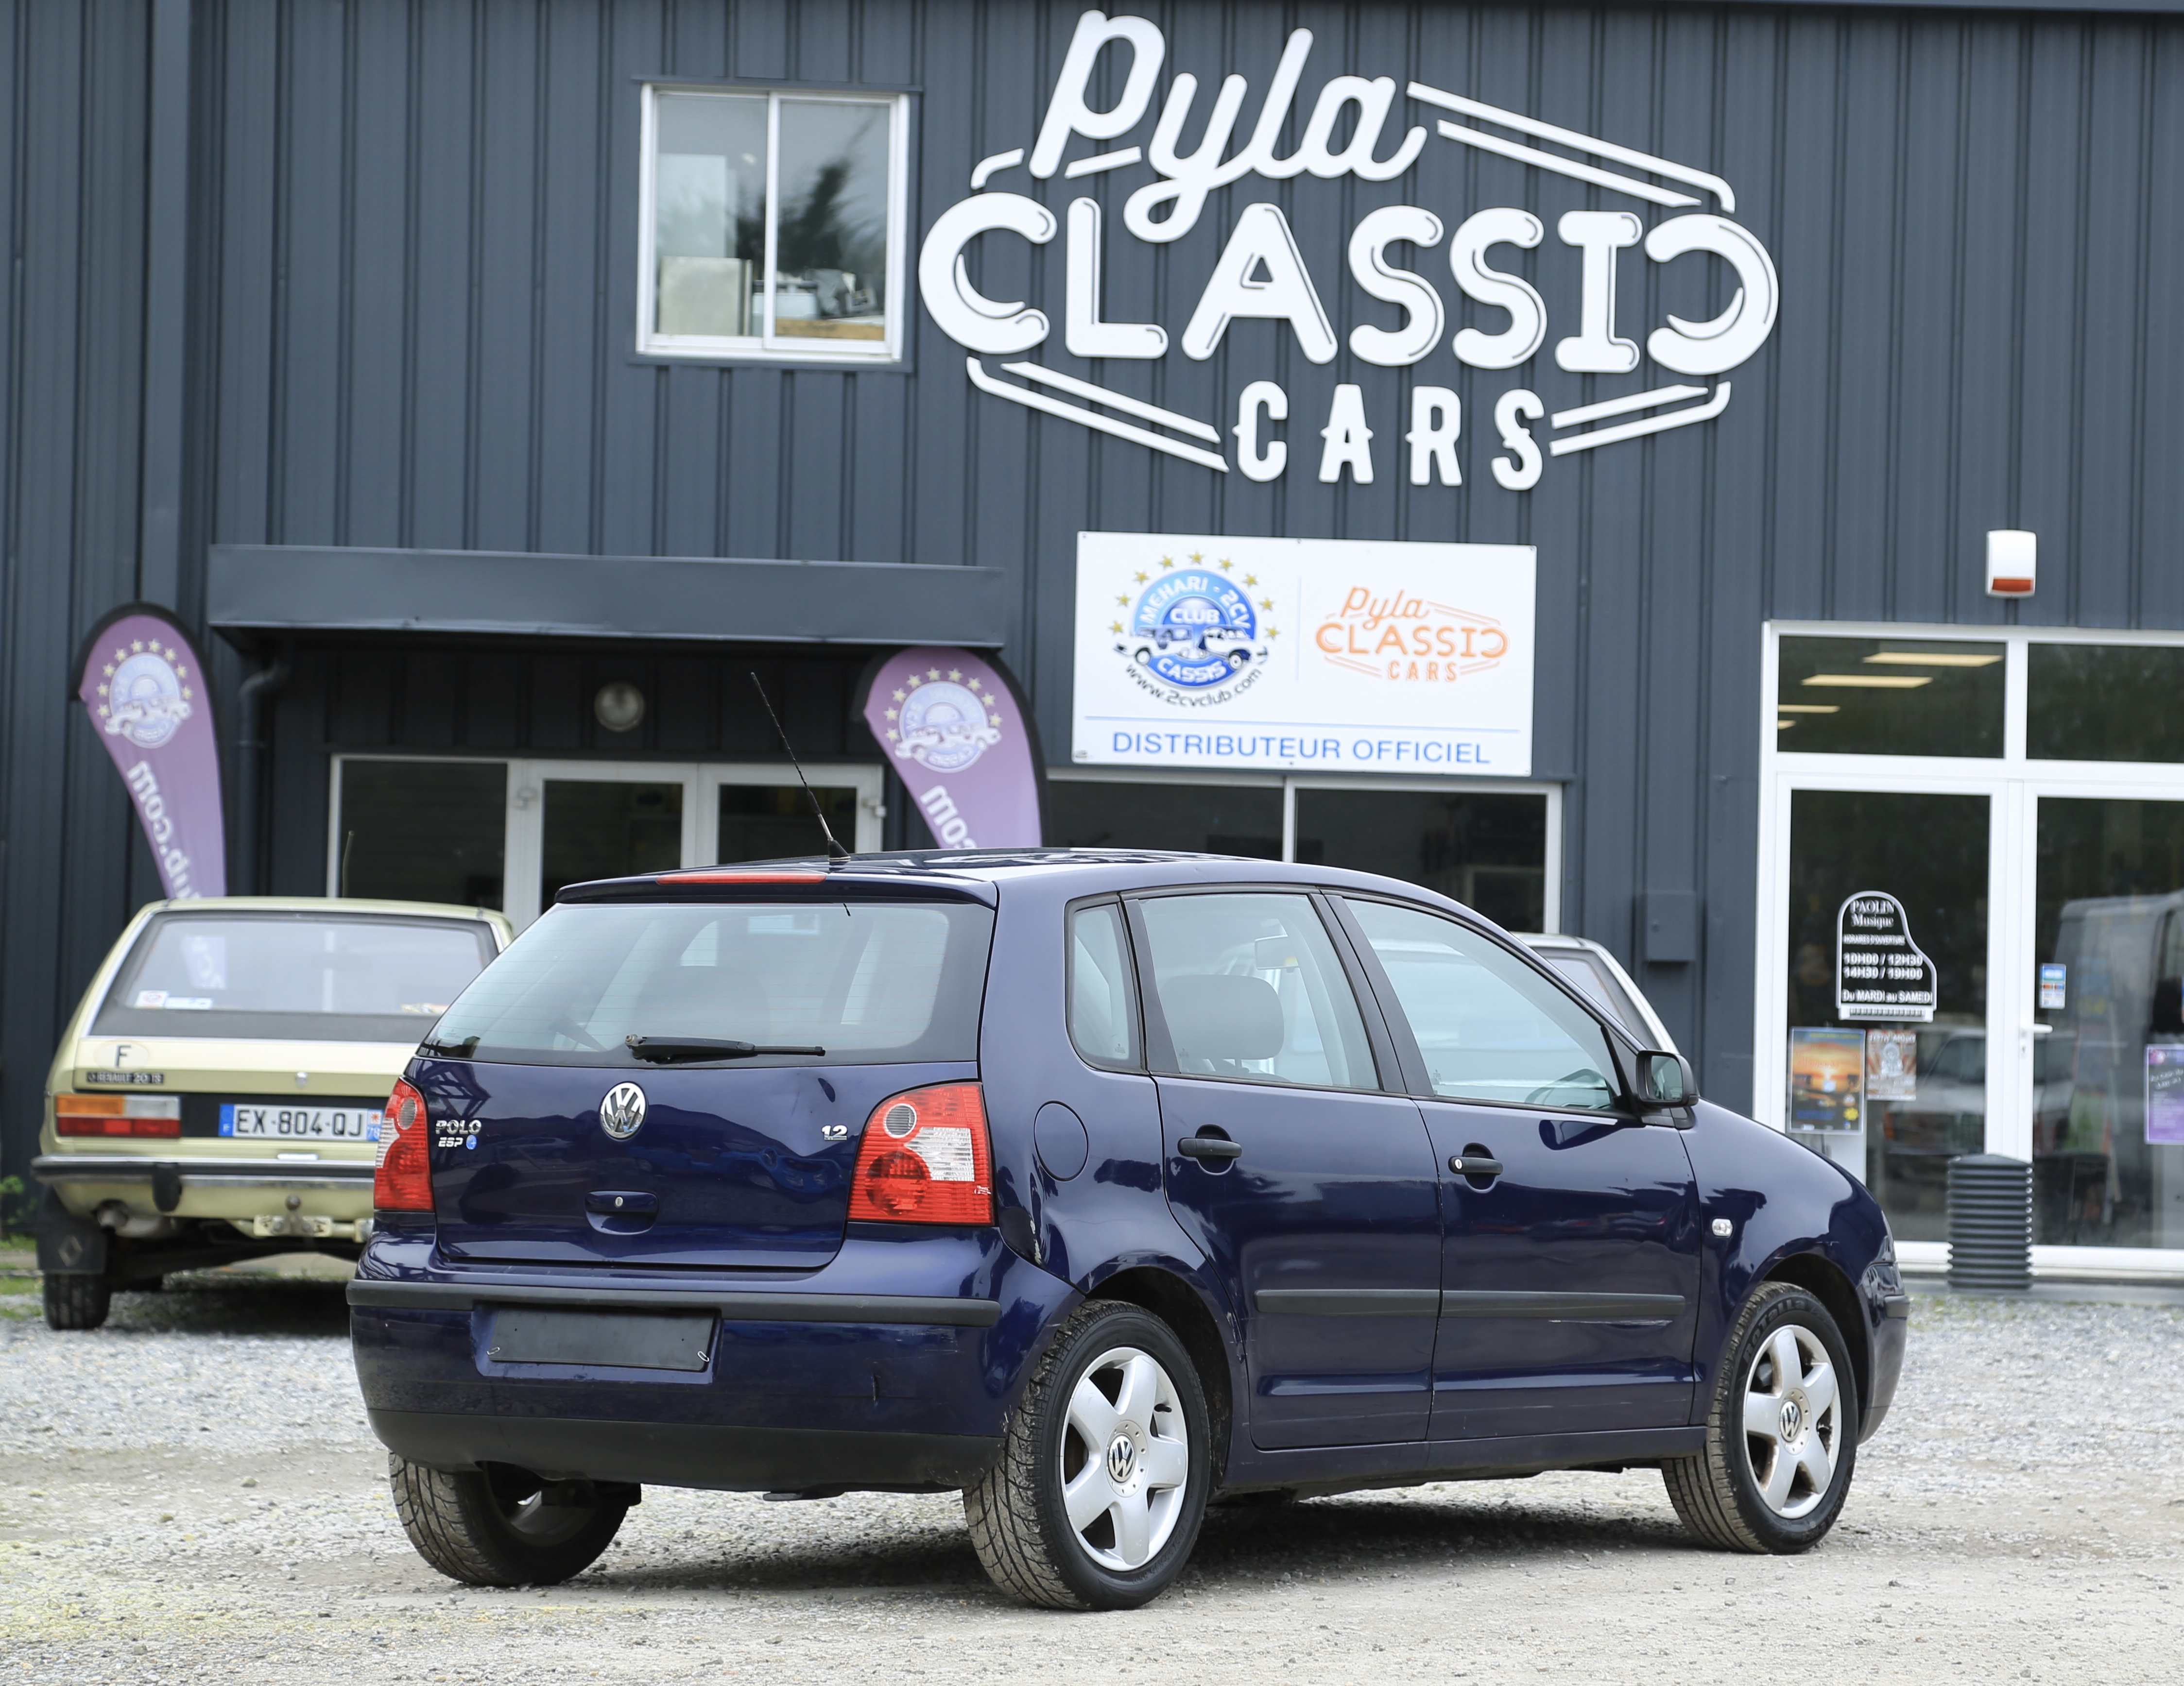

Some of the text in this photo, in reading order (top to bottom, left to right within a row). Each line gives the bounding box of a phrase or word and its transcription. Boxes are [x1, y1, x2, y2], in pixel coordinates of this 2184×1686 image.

[1231, 380, 1545, 491] CARS
[1139, 575, 1209, 626] MEHARI
[1220, 589, 1252, 630] 2CV
[1340, 585, 1431, 630] Pyla
[1169, 607, 1221, 625] CLUB
[1156, 657, 1227, 683] CASSIS
[1385, 660, 1458, 682] CARS
[1126, 664, 1262, 707] www.2cvclub.com
[1112, 732, 1492, 765] DISTRIBUTEUR OFFICIEL
[1850, 900, 1895, 914] PAOLIN
[1851, 913, 1894, 930] Musique
[1843, 934, 1870, 945] HORAIRES
[1843, 952, 1879, 966] 10H00
[1887, 953, 1924, 967] 12H30
[1843, 966, 1879, 978] 14H30
[1887, 967, 1924, 980] 19H00
[1841, 988, 1933, 1004] Du MARDI au SAMEDI
[115, 1044, 132, 1068] F
[98, 1073, 131, 1083] RENAULT
[236, 1109, 362, 1137] EX-804-QJ
[435, 1119, 482, 1135] POLO
[821, 1124, 848, 1141] 1.2
[438, 1137, 464, 1147] ESP
